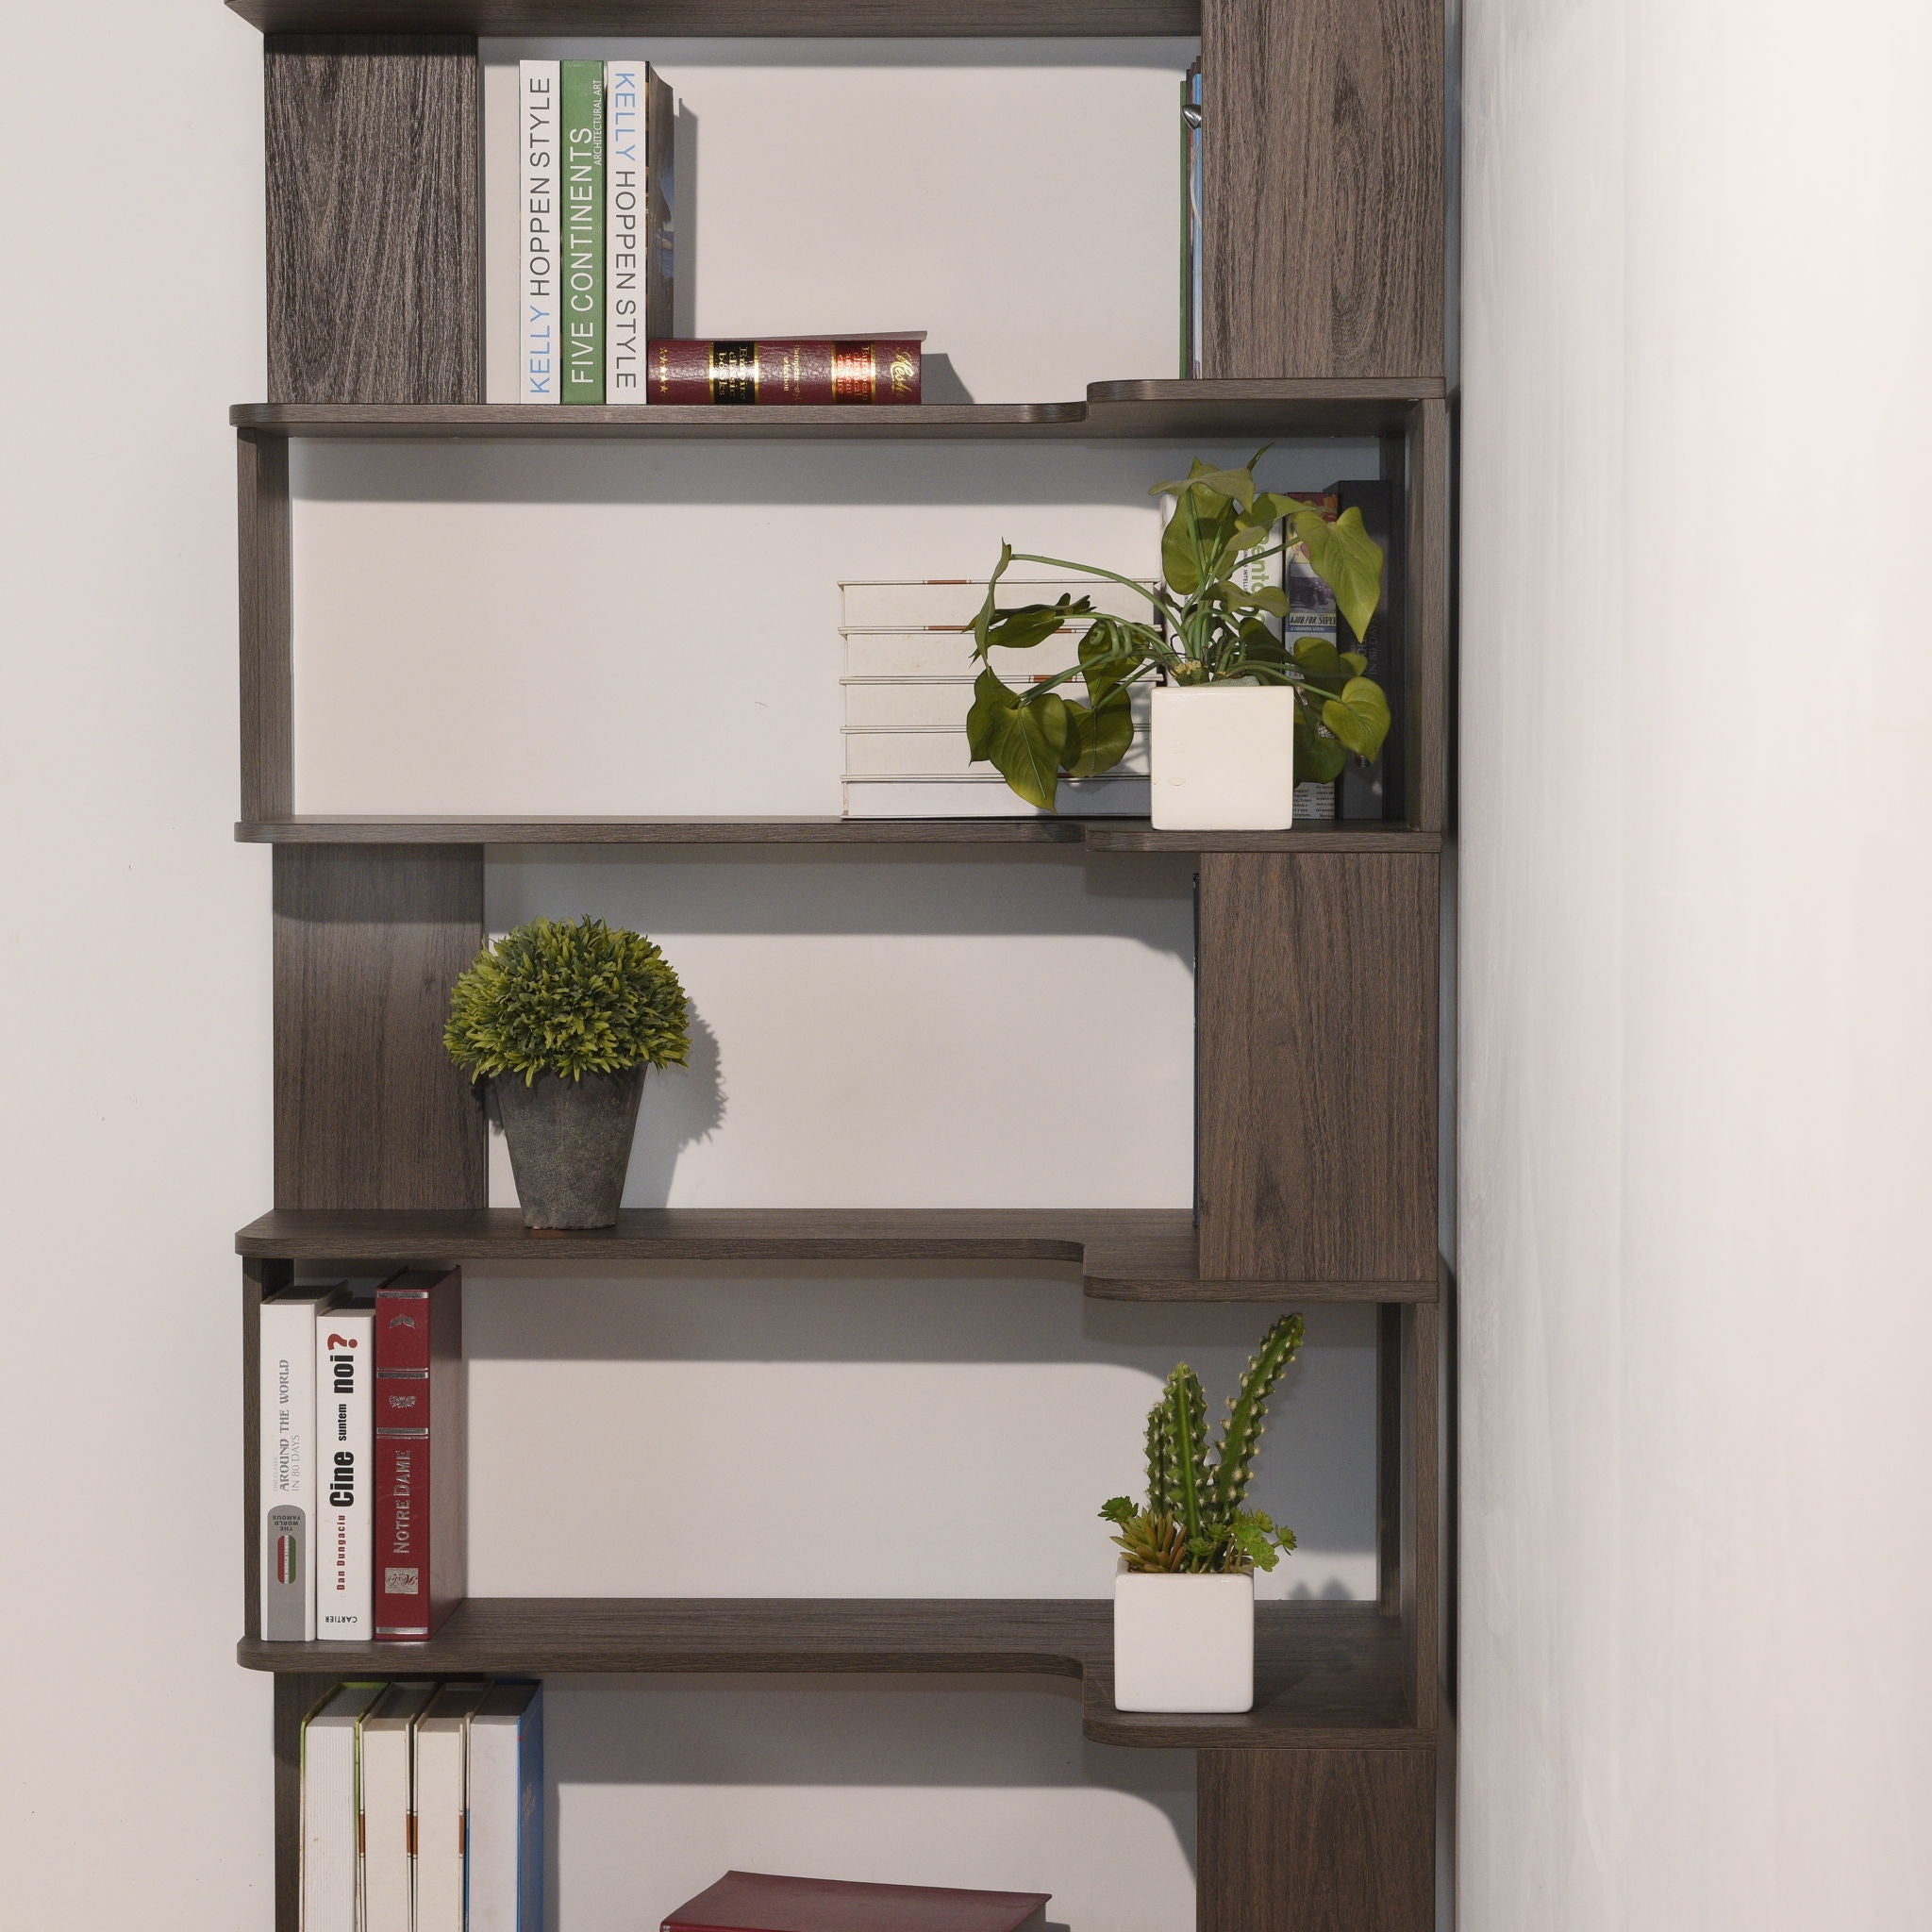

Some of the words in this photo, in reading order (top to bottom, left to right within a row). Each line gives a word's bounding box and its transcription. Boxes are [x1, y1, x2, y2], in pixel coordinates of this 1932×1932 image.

[592, 79, 603, 96] ART
[529, 78, 551, 168] STYLE
[592, 98, 603, 166] ARCHITECTURAL
[614, 73, 636, 161] KELLY
[529, 176, 551, 296] HOPPEN
[569, 126, 594, 312] CONTINENTS
[614, 171, 636, 290] HOPPEN
[529, 305, 551, 393] KELLY
[571, 322, 594, 384] FIVE
[615, 299, 637, 389] STYLE
[1305, 616, 1317, 625] FOR
[279, 1359, 290, 1404] WORLD
[279, 1409, 290, 1433] THE
[337, 1403, 347, 1441] suntem
[279, 1438, 290, 1491] AROUND
[291, 1434, 300, 1461] DAYS
[291, 1464, 300, 1477] 80
[392, 1450, 410, 1496] DAME
[291, 1480, 300, 1491] IN
[329, 1451, 355, 1507] Cine
[337, 1515, 347, 1566] Dungaciu
[392, 1500, 410, 1554] NOTRE
[337, 1571, 345, 1591] Dan
[325, 1615, 358, 1624] CARTIER
